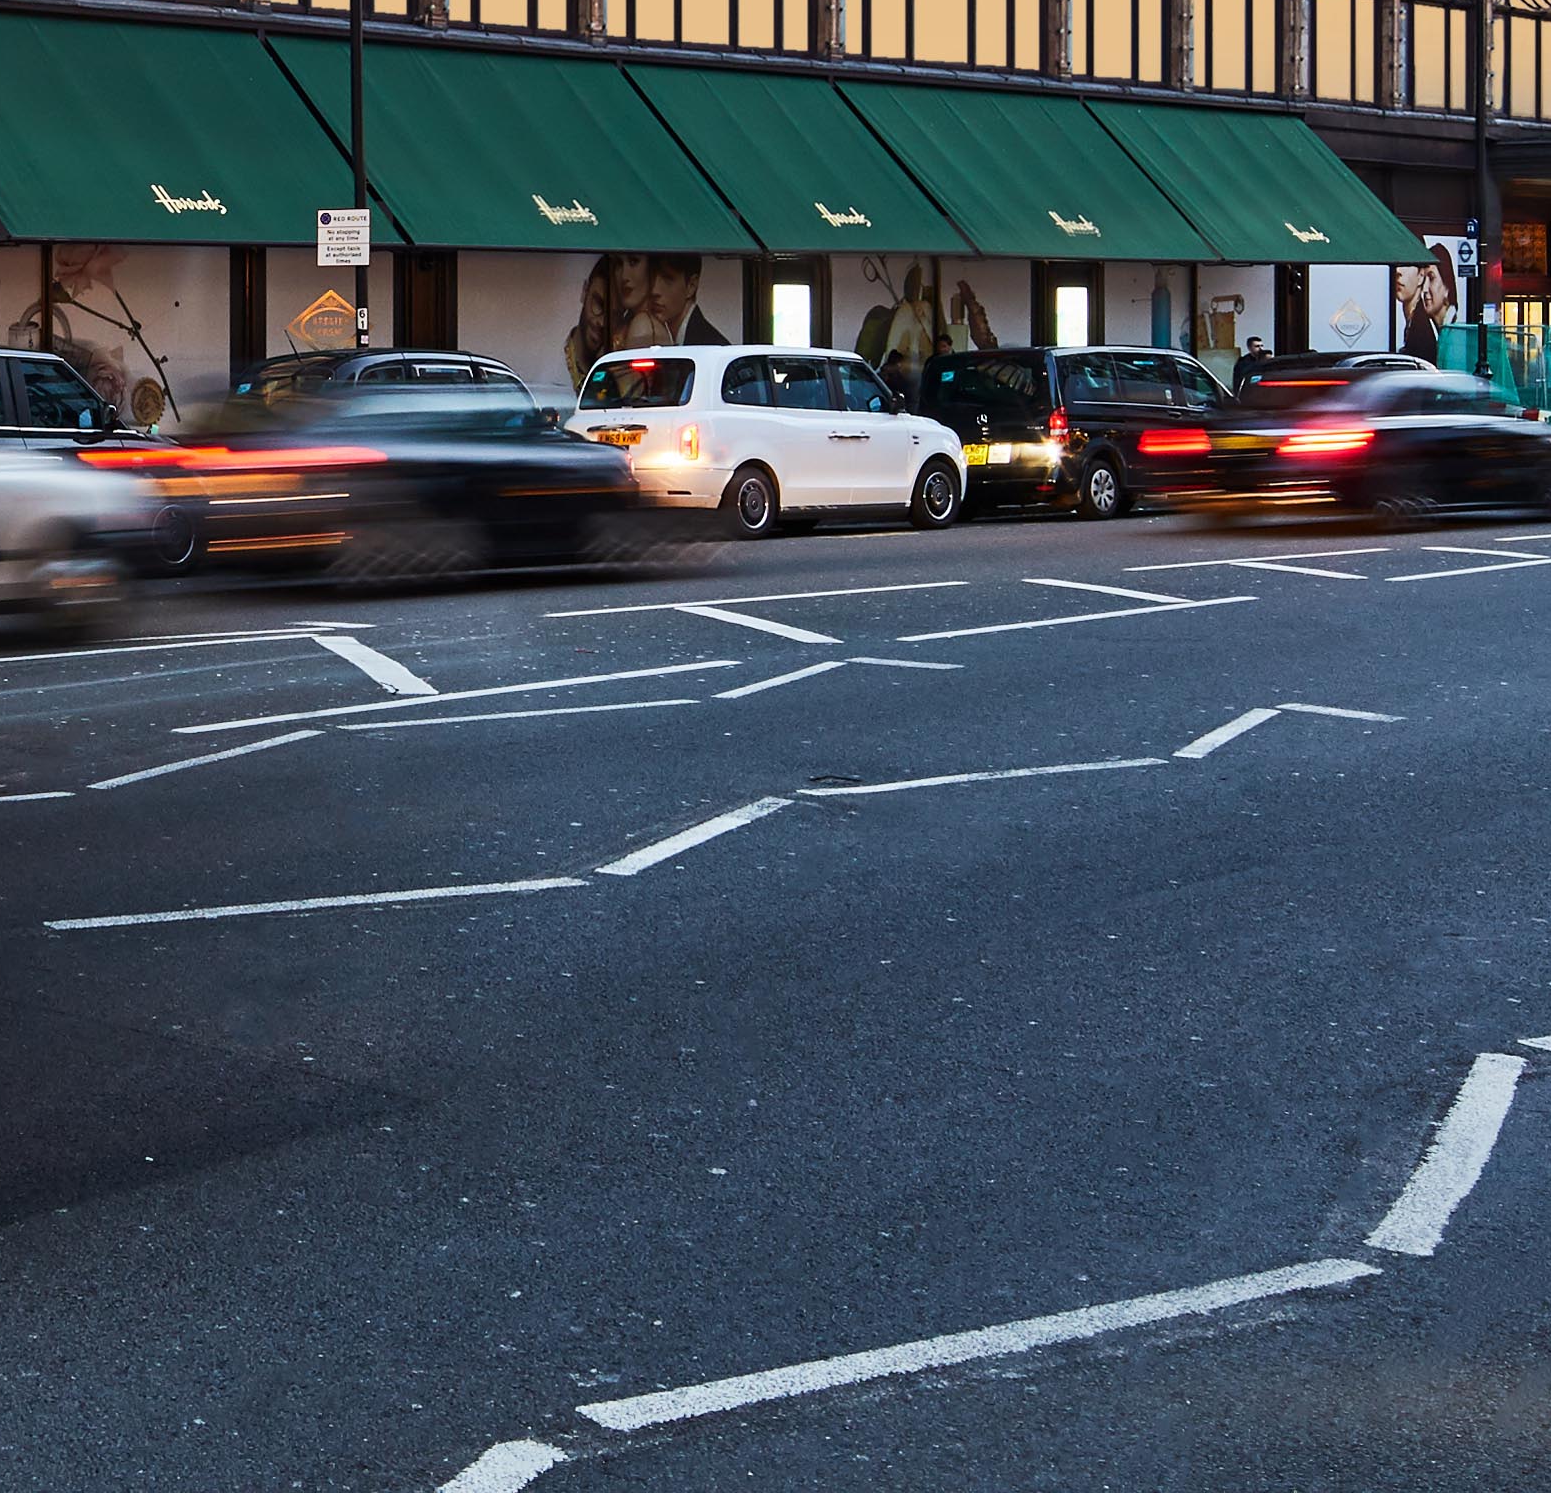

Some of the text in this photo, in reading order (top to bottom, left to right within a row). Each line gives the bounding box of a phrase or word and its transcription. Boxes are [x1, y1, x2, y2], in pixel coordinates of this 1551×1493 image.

[150, 184, 228, 215] Harrods
[532, 194, 599, 226] Harrods
[814, 202, 872, 227] Harrods
